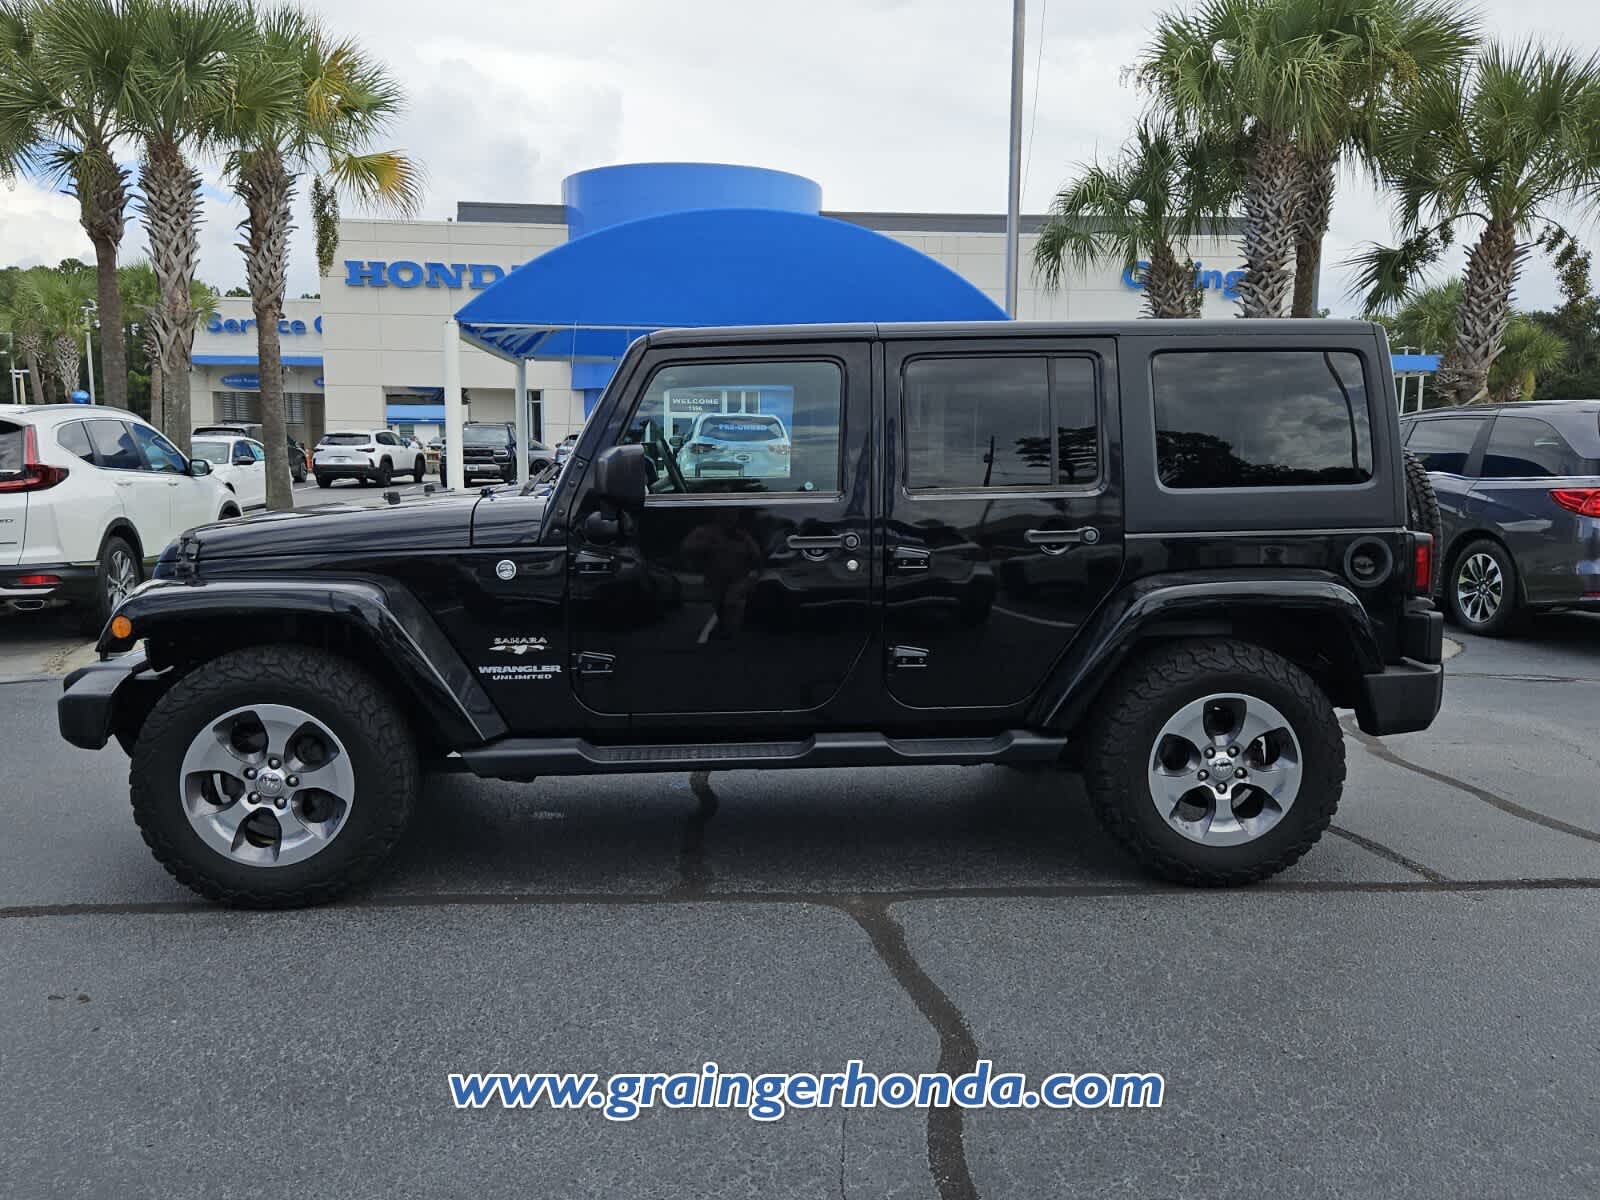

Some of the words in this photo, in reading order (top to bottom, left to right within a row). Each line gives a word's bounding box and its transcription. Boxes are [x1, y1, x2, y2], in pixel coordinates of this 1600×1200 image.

[344, 260, 521, 289] HOND
[206, 311, 307, 334] Serce
[494, 636, 548, 645] SAHARA
[478, 664, 562, 674] WRANGLER
[492, 673, 552, 681] UNLIMITED
